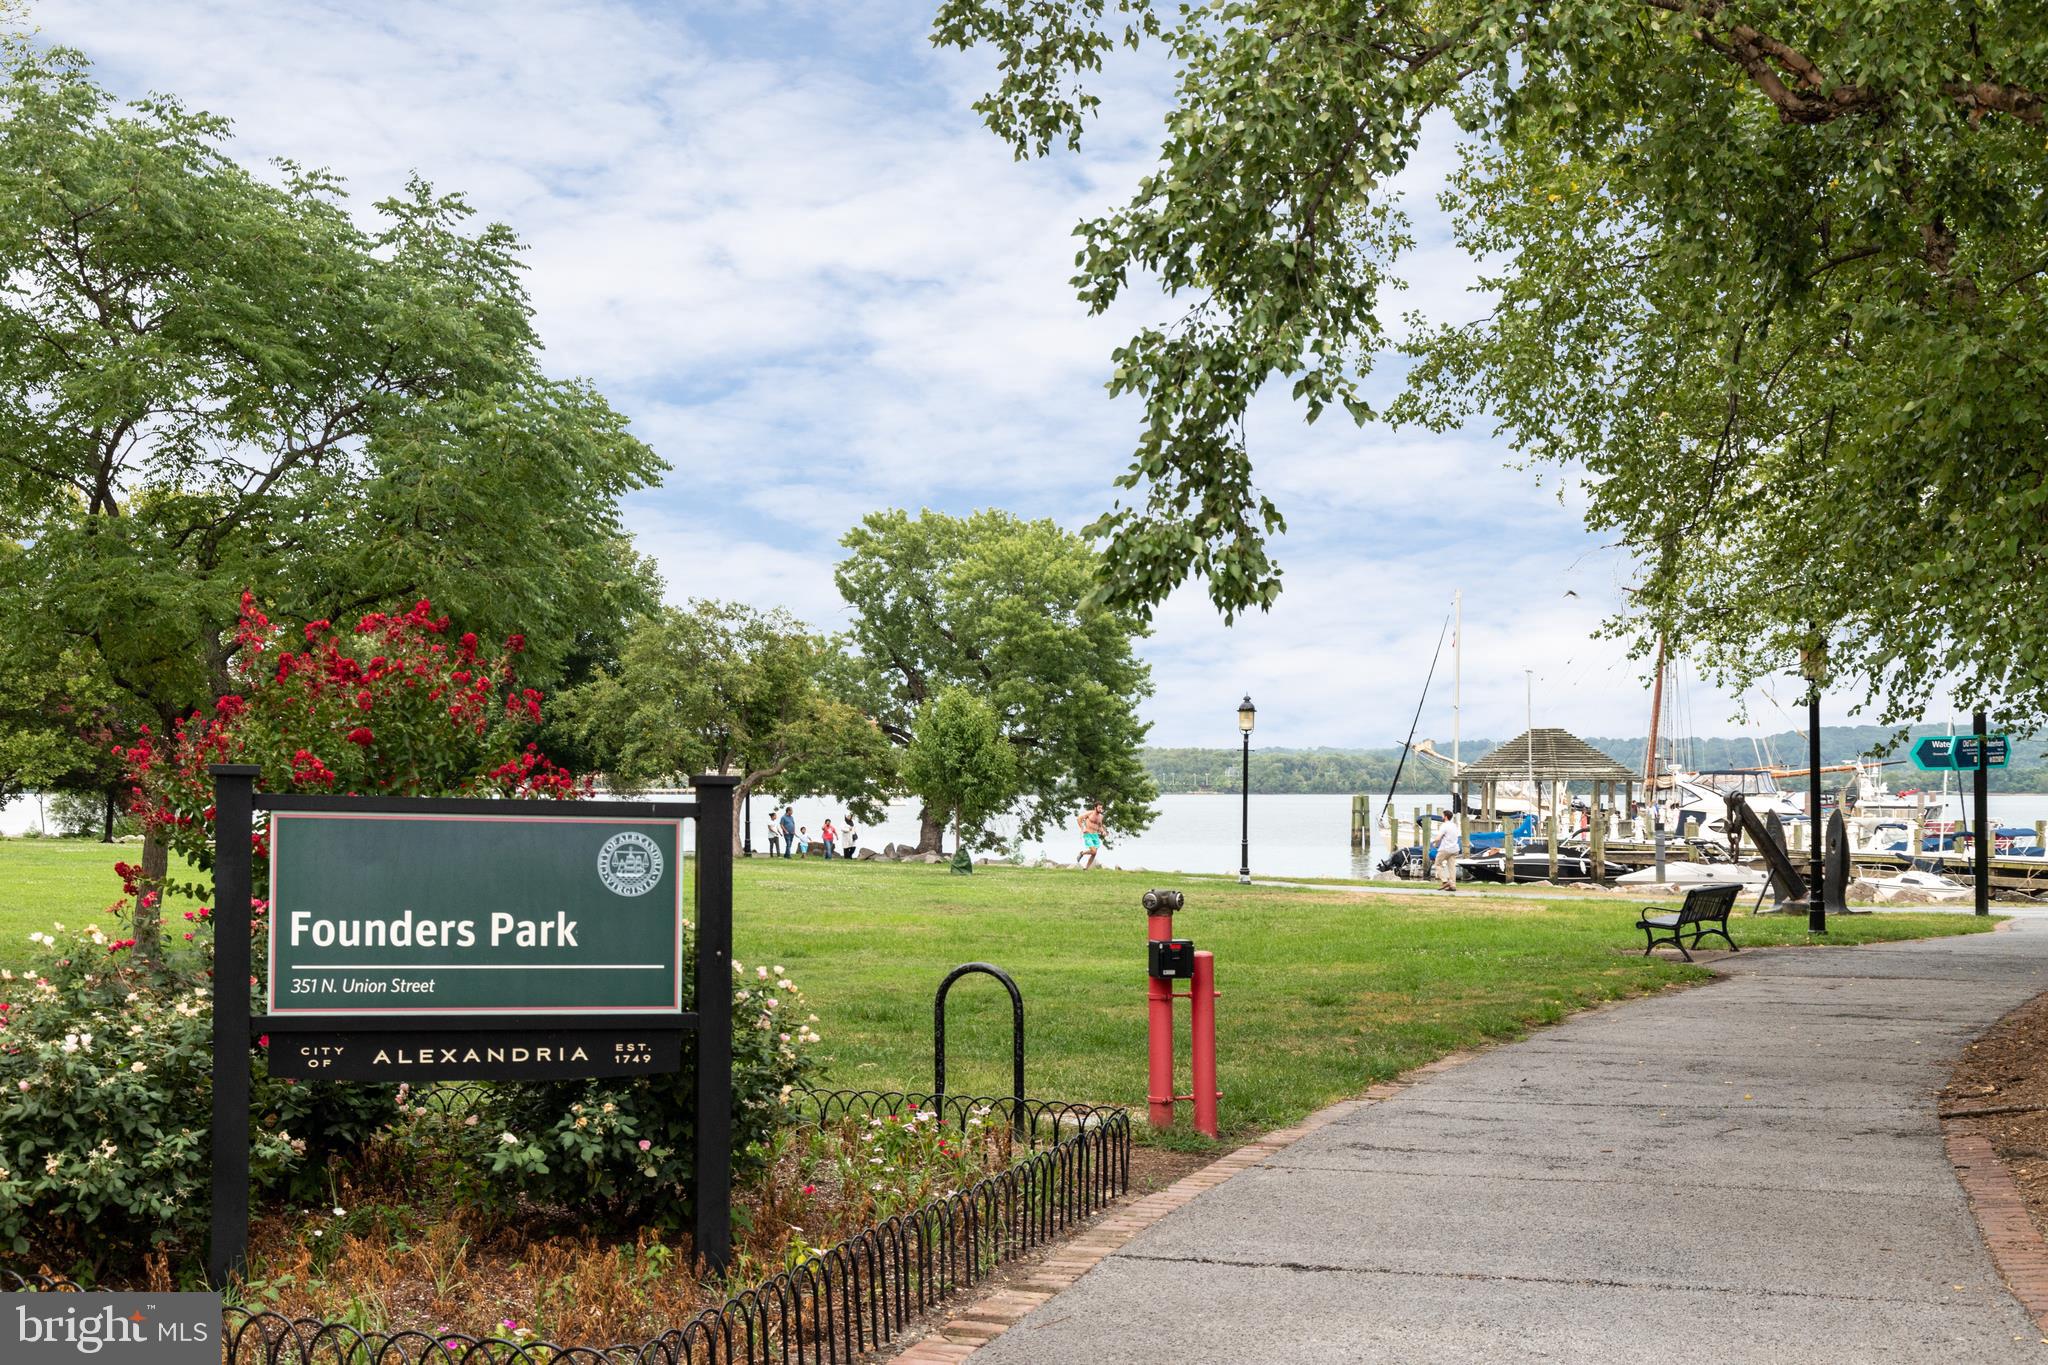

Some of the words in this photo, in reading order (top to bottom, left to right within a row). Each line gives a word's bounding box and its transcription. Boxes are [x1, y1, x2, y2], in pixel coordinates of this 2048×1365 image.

[619, 834, 661, 875] ALEXANDRIA
[607, 877, 656, 894] VIRGINIA
[290, 909, 476, 947] Founders
[490, 910, 579, 947] Park
[290, 978, 318, 993] 351
[321, 979, 337, 993] N.
[342, 979, 387, 993] Union
[390, 979, 435, 993] Street
[300, 1046, 344, 1056] CITY
[614, 1043, 652, 1052] EST.
[372, 1046, 589, 1065] ALEXANDRIA
[613, 1054, 652, 1064] 1749
[307, 1059, 333, 1068] OF
